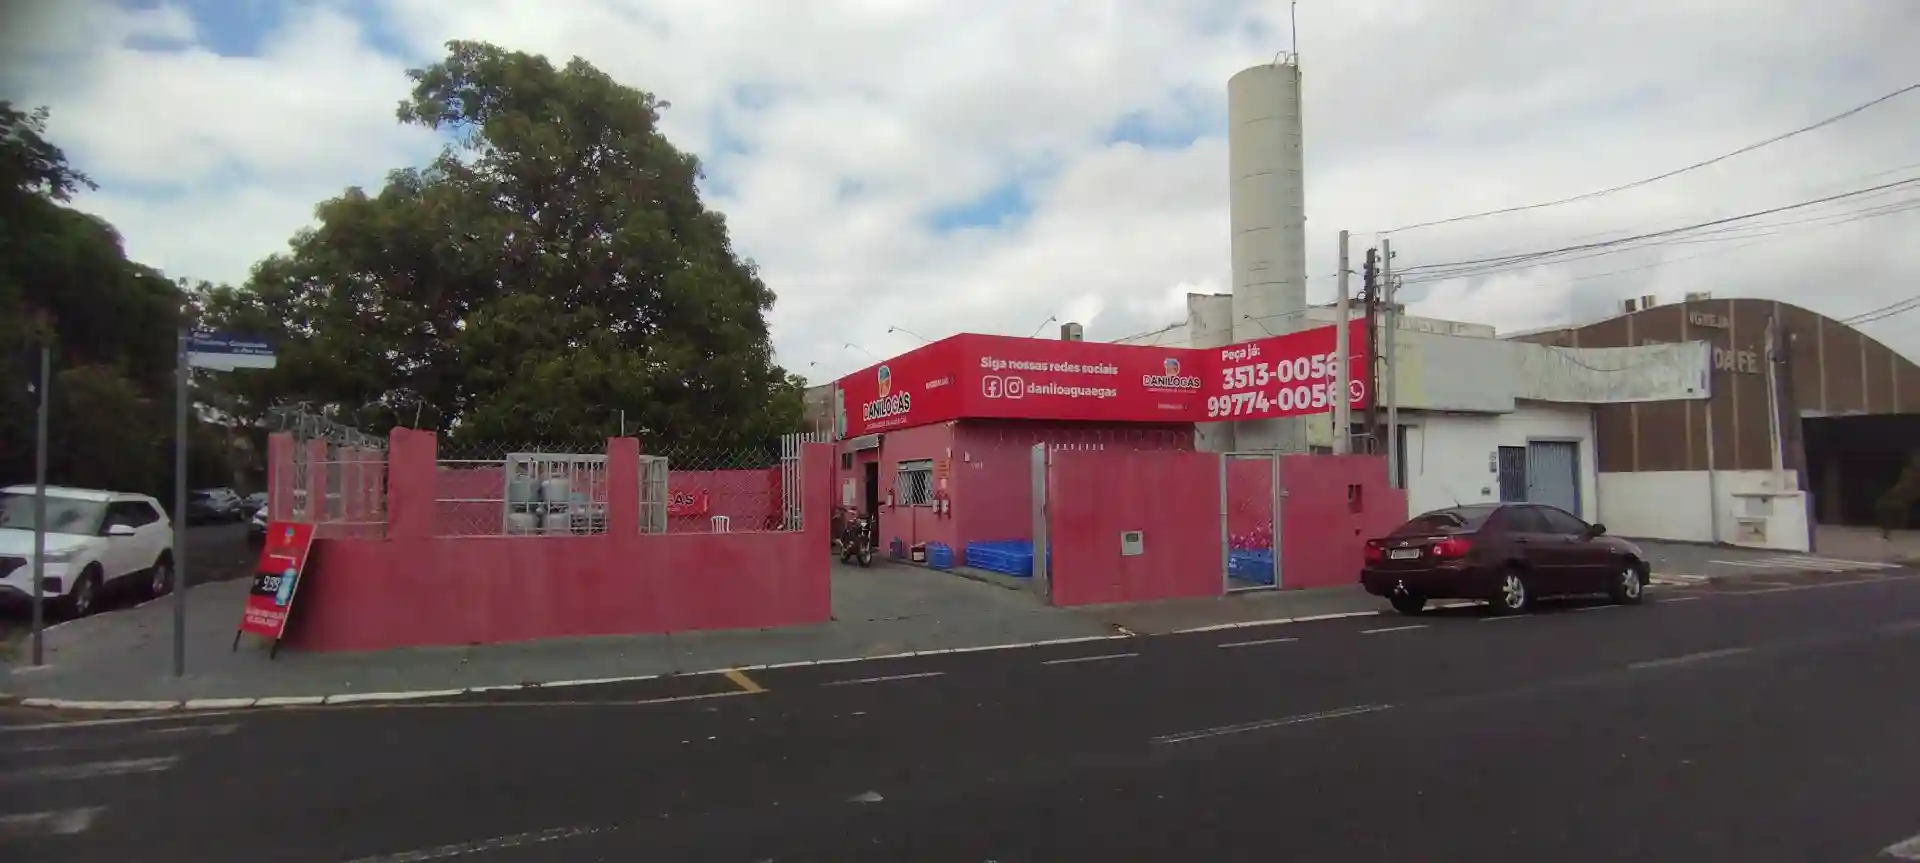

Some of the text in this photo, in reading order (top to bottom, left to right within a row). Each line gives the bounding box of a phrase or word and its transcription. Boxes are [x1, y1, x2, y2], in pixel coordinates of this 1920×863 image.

[1222, 349, 1246, 362] Peça
[981, 356, 1119, 375] Siga nossas redes sociais
[1027, 382, 1117, 398] daniloaguaegas
